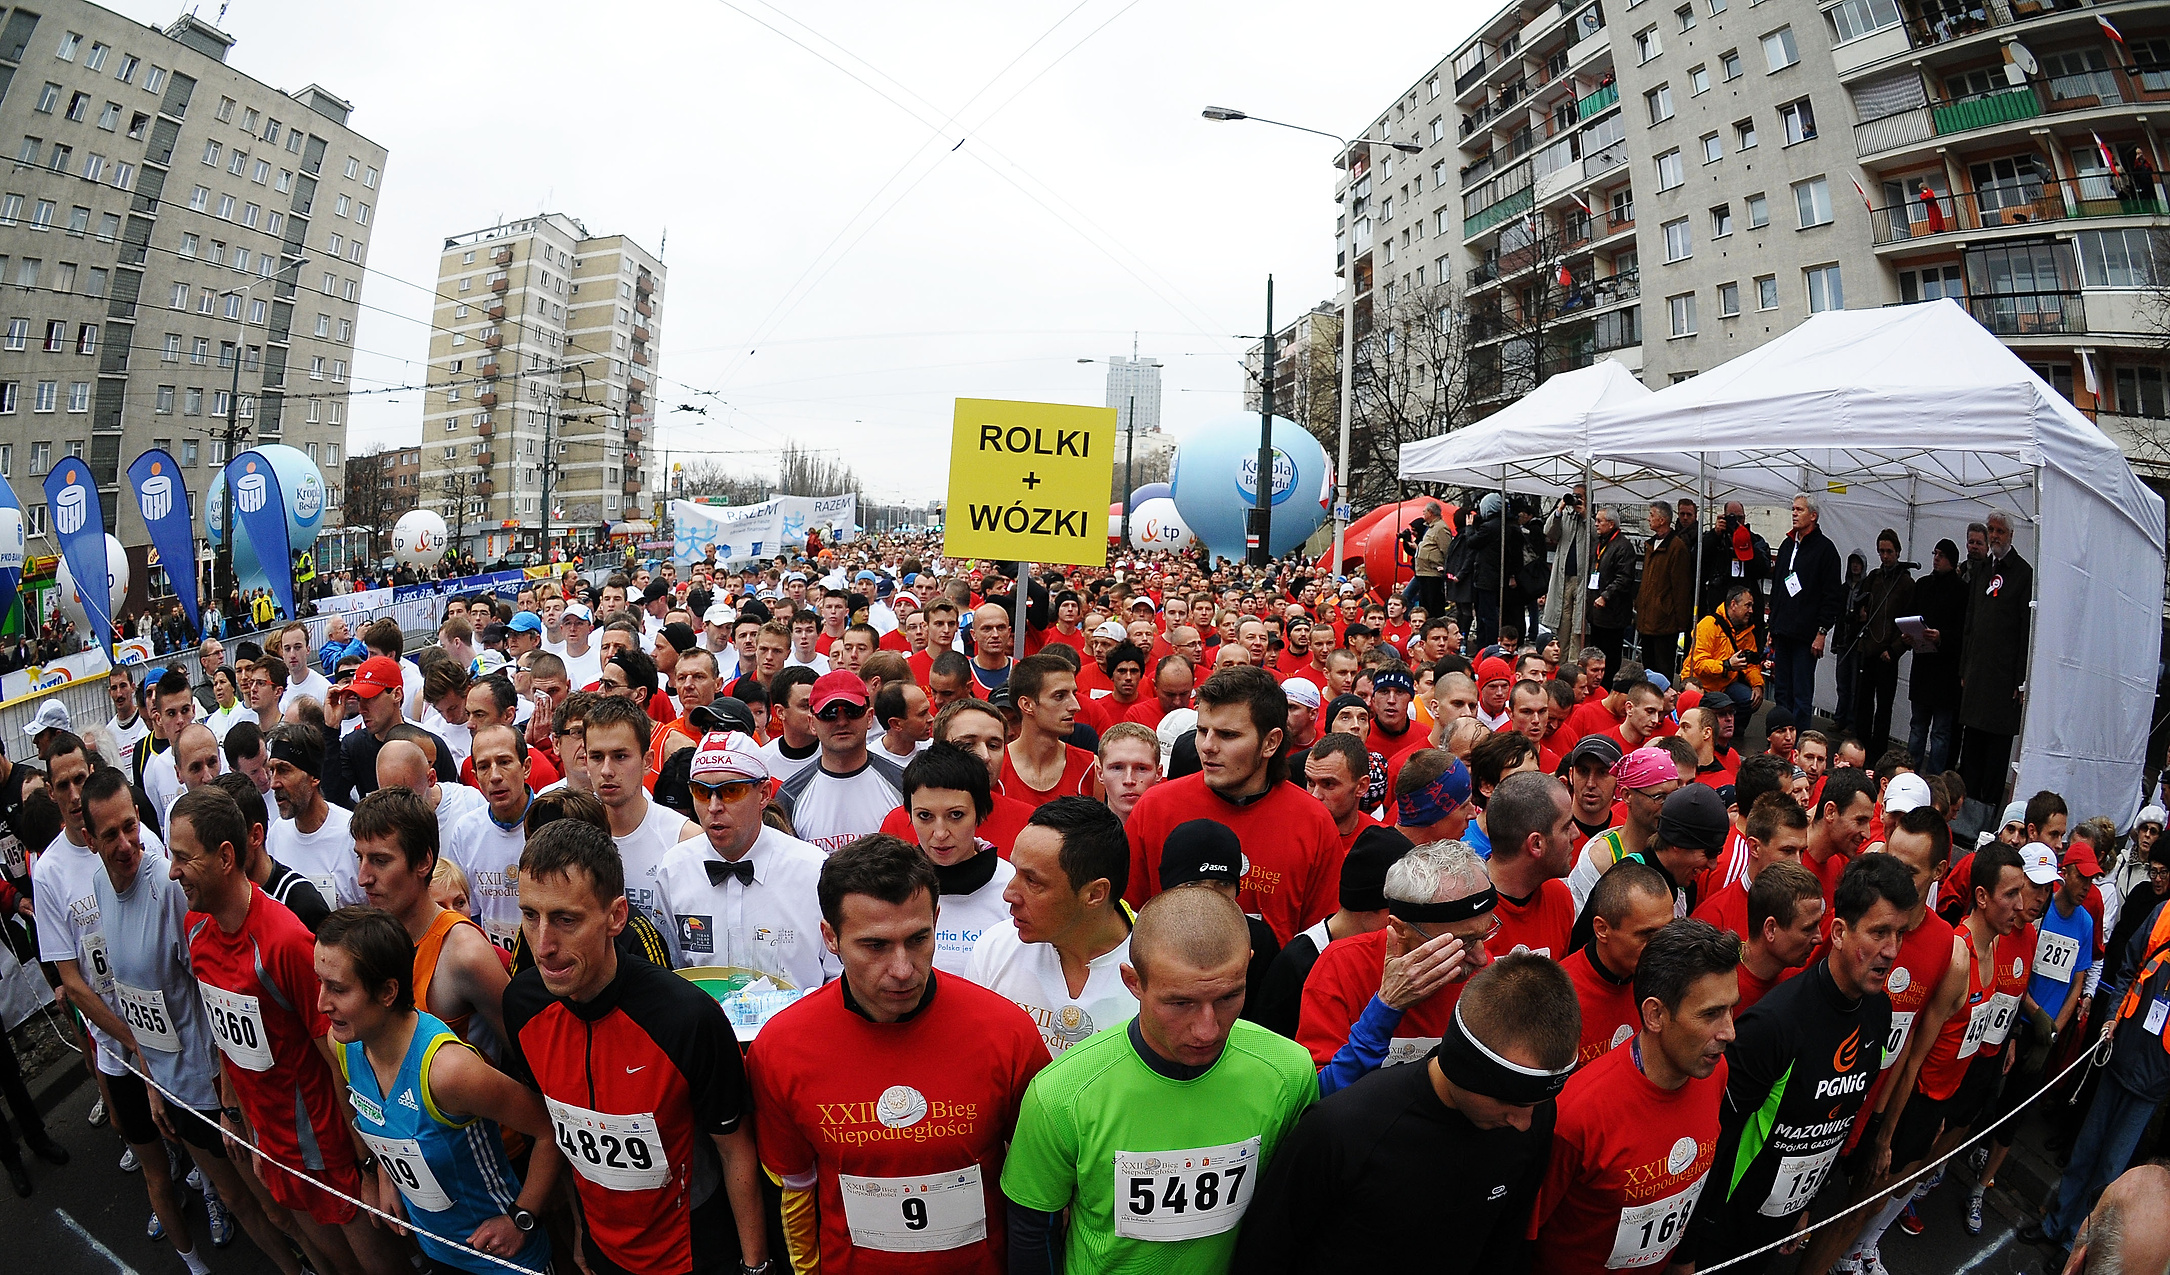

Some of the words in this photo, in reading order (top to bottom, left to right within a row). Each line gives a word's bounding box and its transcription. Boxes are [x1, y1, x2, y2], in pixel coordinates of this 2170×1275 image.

[979, 424, 1090, 458] ROLKI
[1242, 457, 1292, 476] Krpla
[1021, 471, 1041, 490] +
[814, 497, 851, 512] RAZEM
[968, 500, 1089, 538] WÓZKI
[394, 537, 405, 551] tp
[432, 535, 444, 549] tp
[1163, 525, 1180, 542] tp
[694, 755, 733, 767] POLSKA
[2, 842, 26, 868] 4052
[475, 871, 502, 886] XXII
[1208, 864, 1228, 872] asics
[1250, 865, 1281, 885] Bieg
[937, 943, 960, 952] Polska
[2042, 944, 2071, 968] 287
[1909, 980, 1928, 997] Bieg
[120, 998, 168, 1035] 2355
[205, 1000, 258, 1050] 2360
[1579, 1038, 1612, 1063] XXII
[1814, 1071, 1867, 1100] PGNiG
[816, 1101, 879, 1125] XXII
[930, 1100, 978, 1120] Bieg
[557, 1121, 653, 1170] 4829
[820, 1119, 975, 1148] Niepodległości
[1121, 1161, 1144, 1170] XXII
[1162, 1162, 1179, 1170] Bieg
[1623, 1156, 1669, 1187] XXII
[845, 1182, 865, 1191] XXII
[1128, 1164, 1248, 1216] 5487
[901, 1197, 929, 1231] 9
[1639, 1199, 1693, 1250] 168
